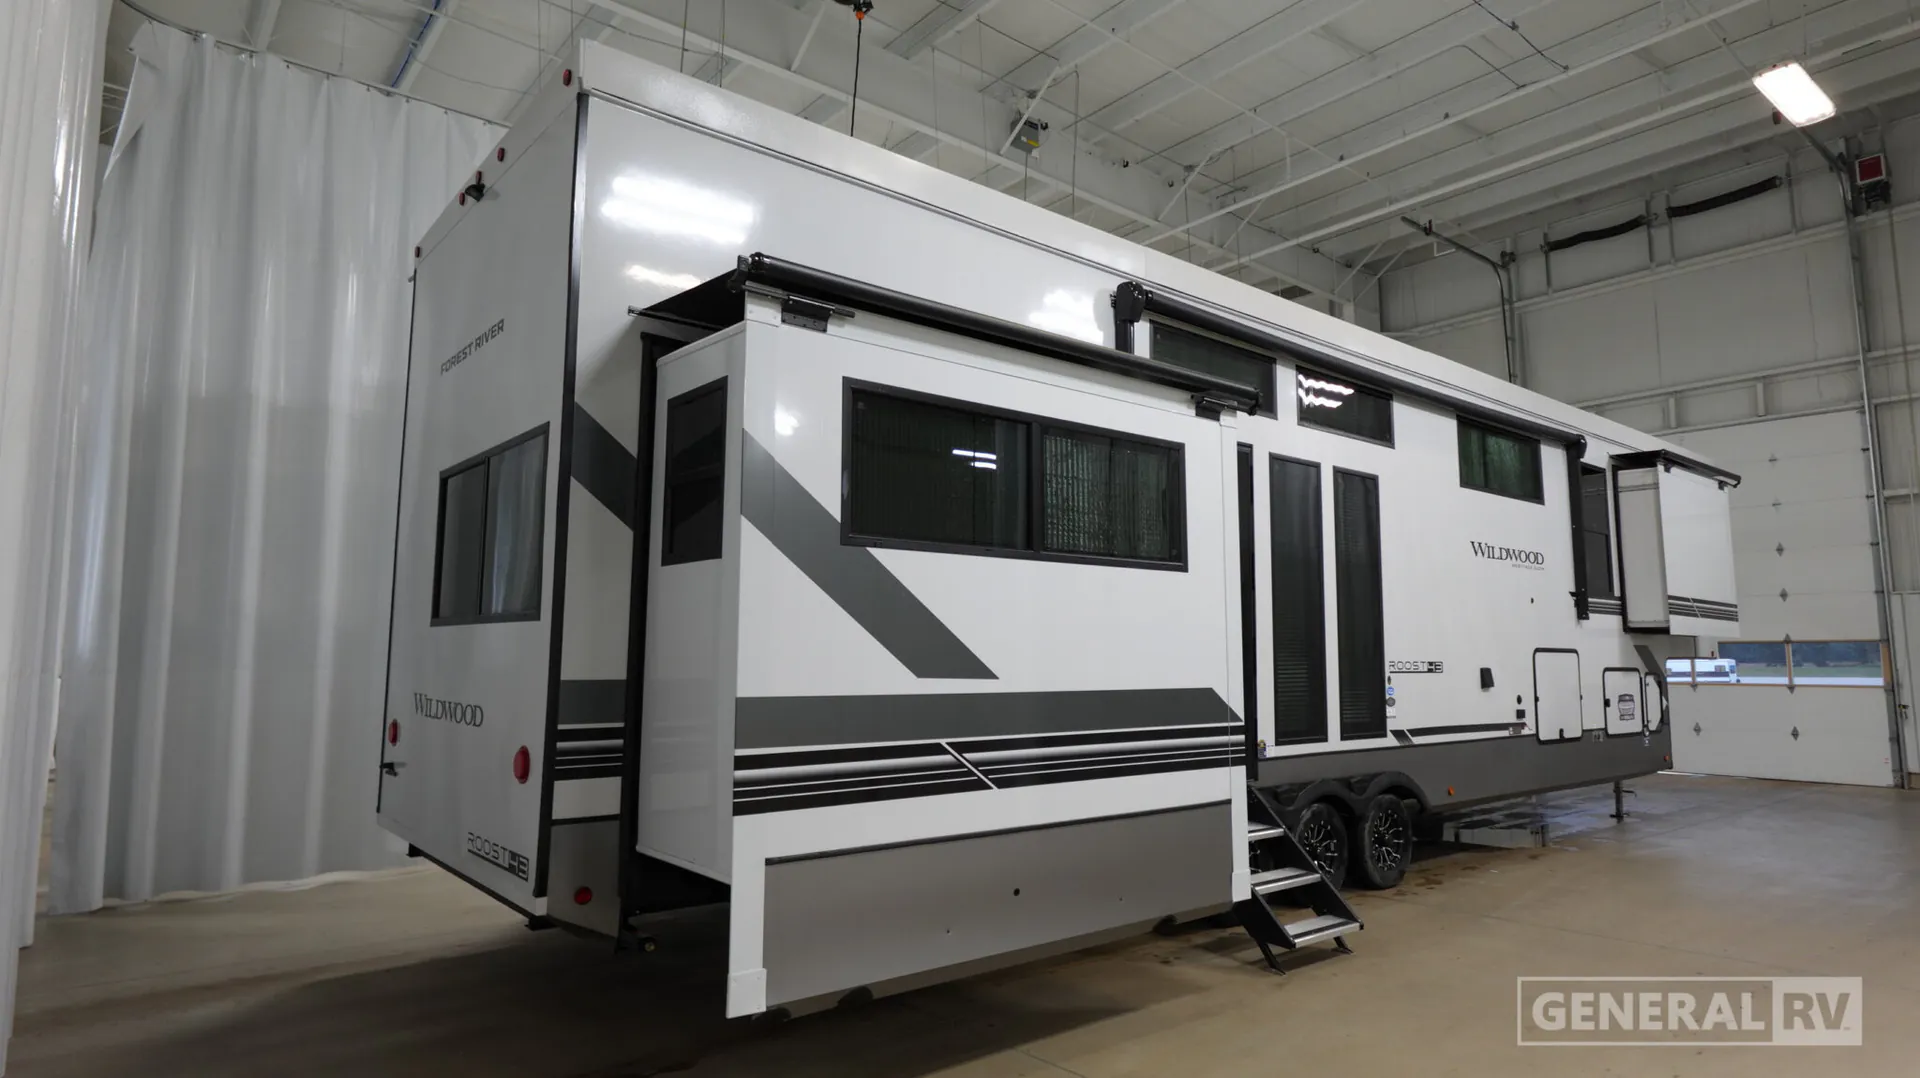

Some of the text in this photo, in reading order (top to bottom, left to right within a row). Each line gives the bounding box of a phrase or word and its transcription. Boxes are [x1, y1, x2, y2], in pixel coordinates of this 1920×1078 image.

[440, 318, 505, 376] FOREST RIVER
[1469, 540, 1545, 565] WILDWOOD
[413, 692, 484, 727] WILDWOOD
